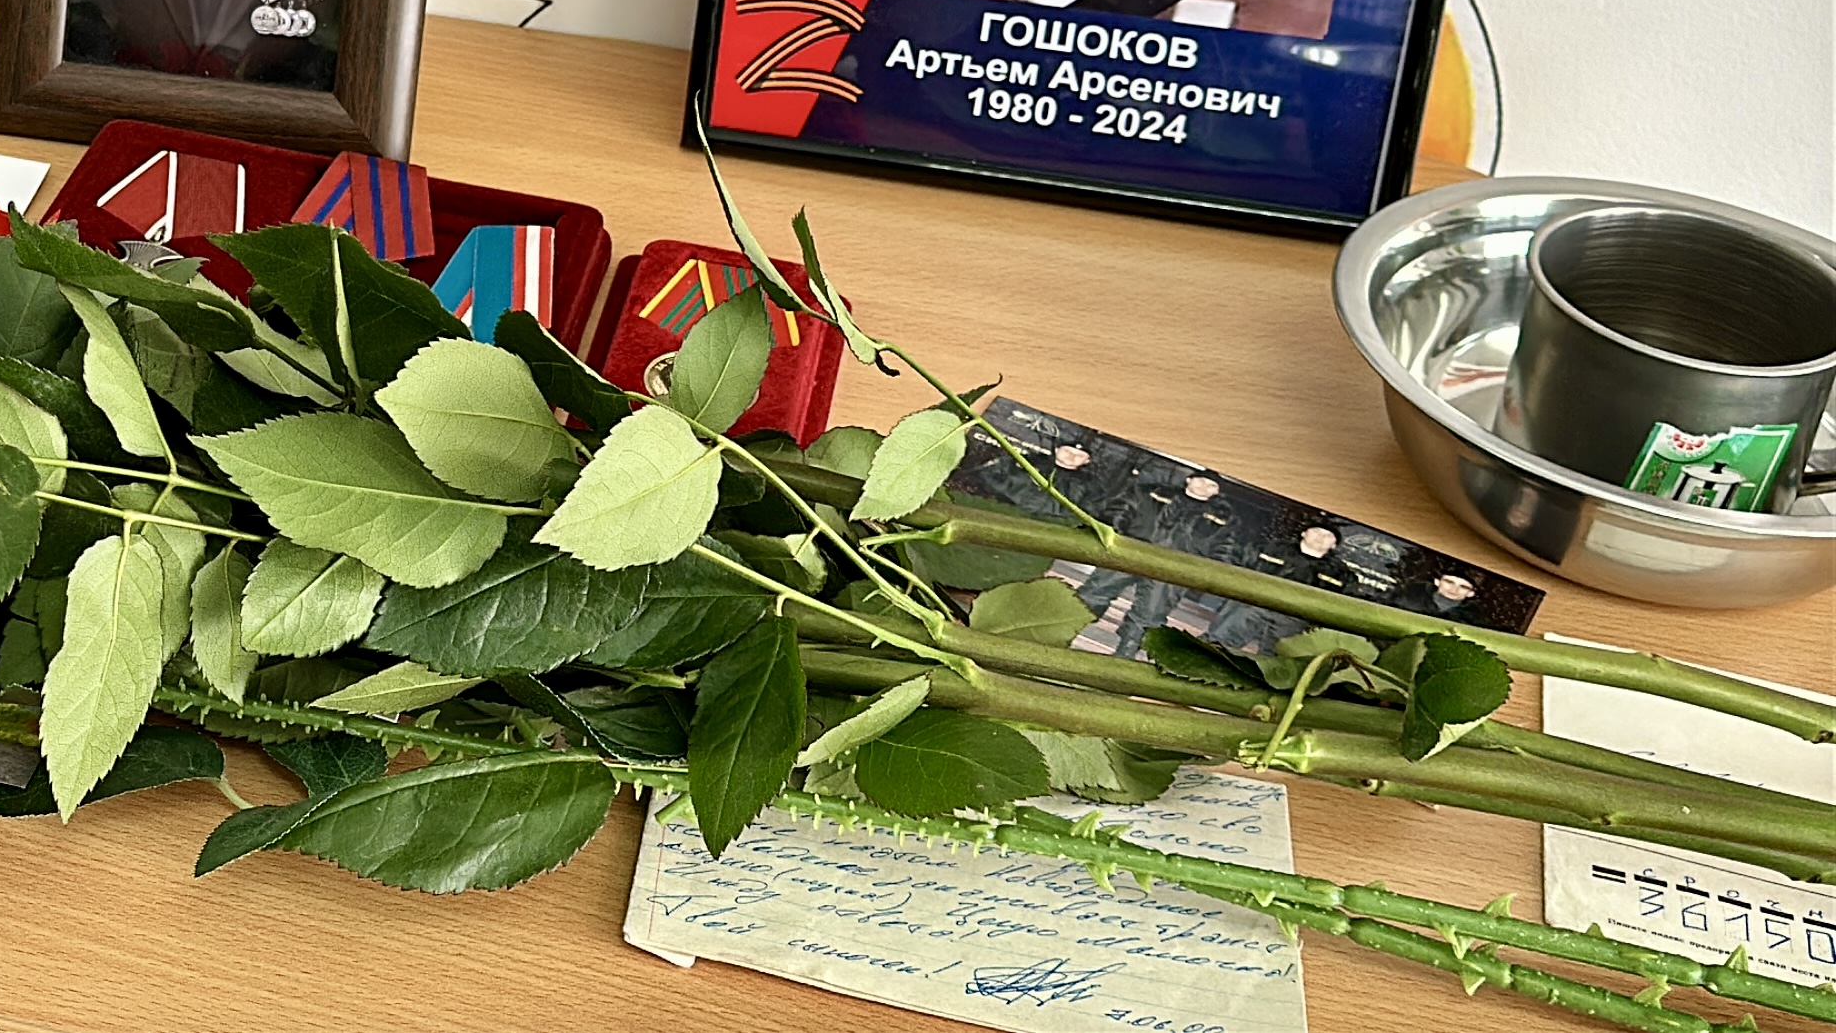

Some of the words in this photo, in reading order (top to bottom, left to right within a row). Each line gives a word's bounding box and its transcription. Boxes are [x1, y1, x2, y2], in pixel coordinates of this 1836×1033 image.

[979, 11, 1199, 69] ГОШОКОВ
[885, 38, 1040, 87] Артьем
[1048, 60, 1282, 119] Арсенович
[967, 86, 1058, 127] 1980
[1092, 104, 1188, 145] 2024
